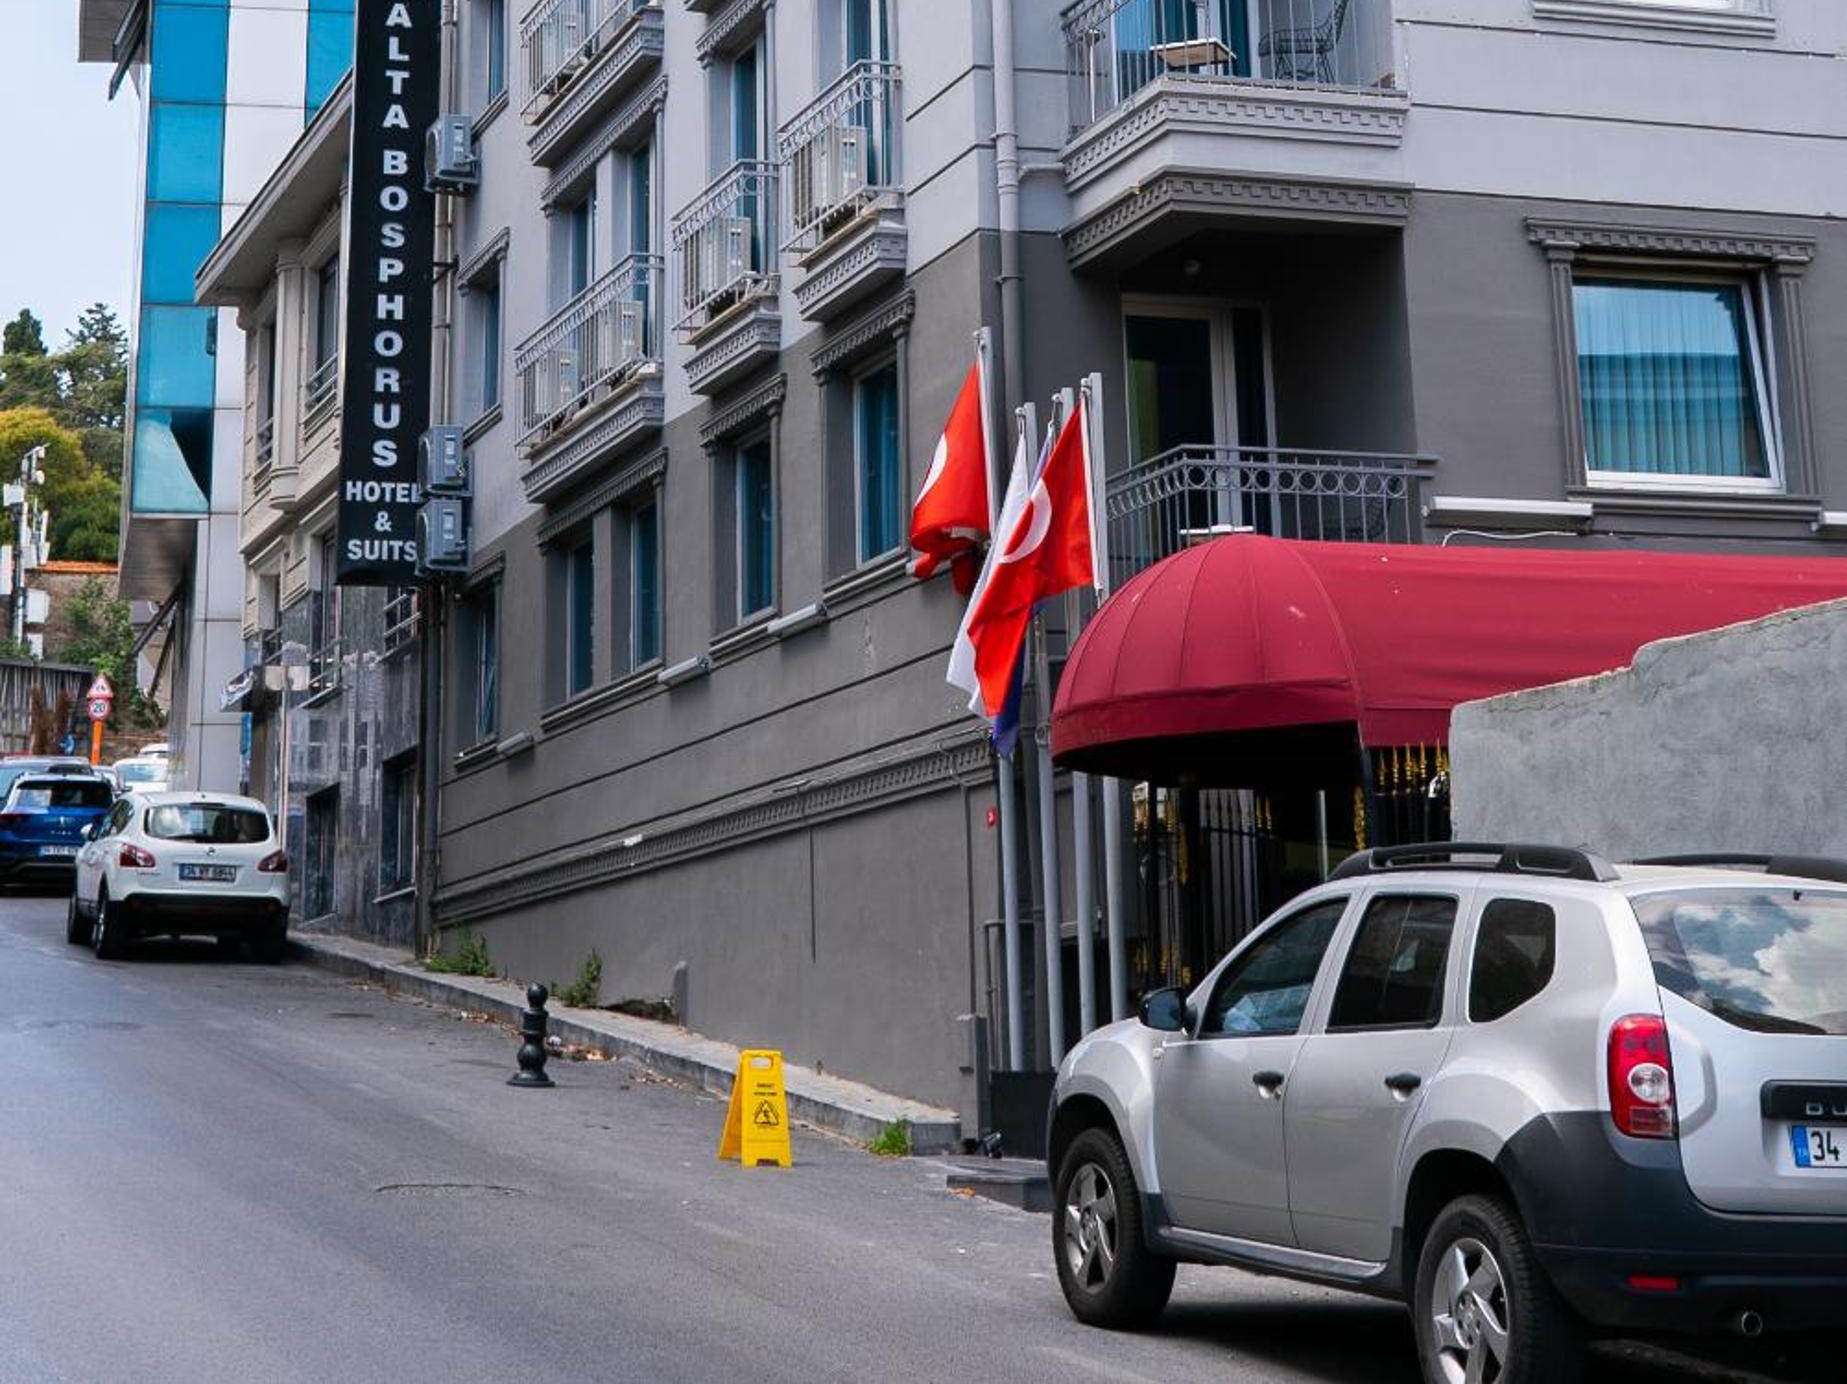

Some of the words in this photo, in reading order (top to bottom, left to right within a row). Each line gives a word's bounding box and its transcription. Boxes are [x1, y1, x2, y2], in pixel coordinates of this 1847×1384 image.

[372, 149, 409, 468] BOSPHORUS
[345, 480, 420, 503] HOTEL
[374, 510, 392, 532] &
[347, 538, 418, 562] SUITS
[93, 701, 106, 713] 20
[1810, 1130, 1840, 1162] 34
